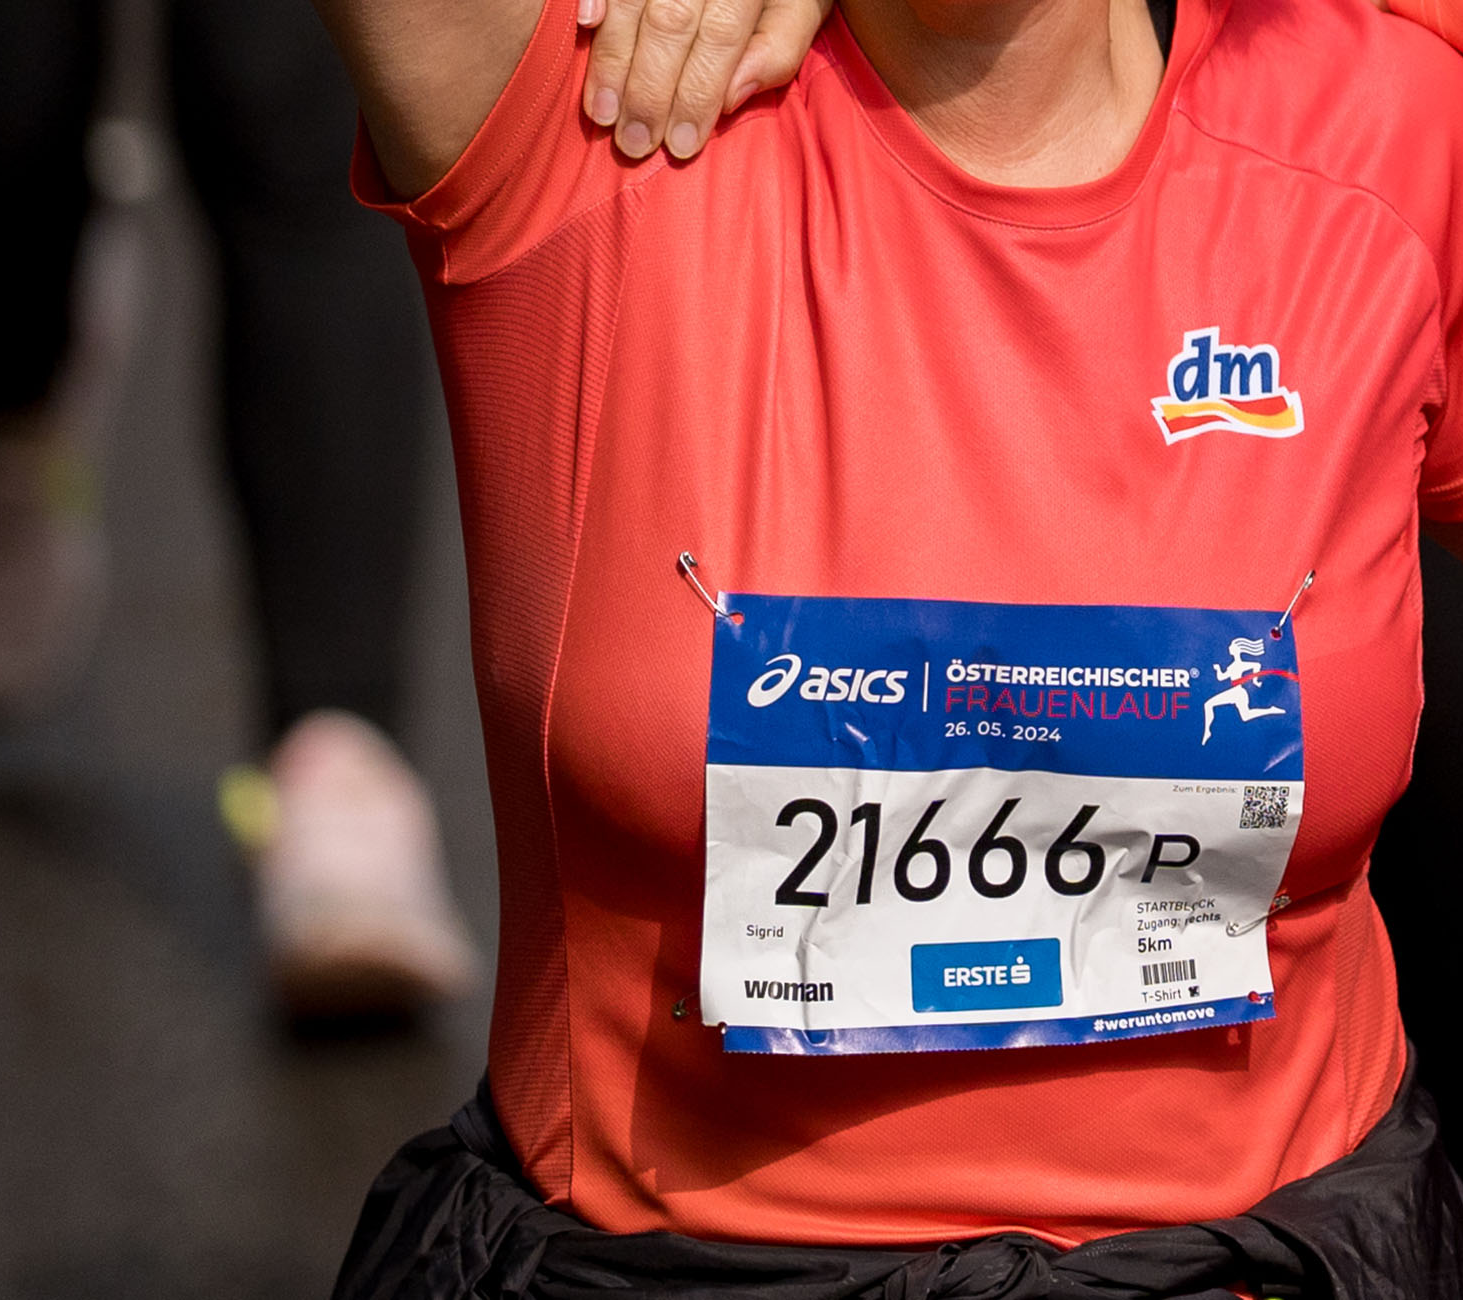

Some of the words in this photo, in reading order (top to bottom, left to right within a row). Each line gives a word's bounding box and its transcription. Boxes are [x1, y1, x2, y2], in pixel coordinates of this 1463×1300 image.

[1173, 335, 1273, 402] dm
[944, 685, 1192, 721] FRAUENLAUF
[944, 721, 971, 738] 26.
[977, 720, 1006, 738] 05.
[1012, 725, 1062, 743] 2024
[1172, 785, 1194, 793] Zum
[774, 796, 1108, 908] 21666
[1140, 833, 1201, 885] P
[745, 924, 784, 939] Sigrid
[1137, 918, 1181, 932] Zugang:
[1138, 937, 1173, 953] 5km
[943, 965, 1008, 988] ERSTE
[744, 979, 834, 1002] woman
[1142, 988, 1182, 1004] T-Shirt
[1093, 1007, 1216, 1033] #weruntomove
